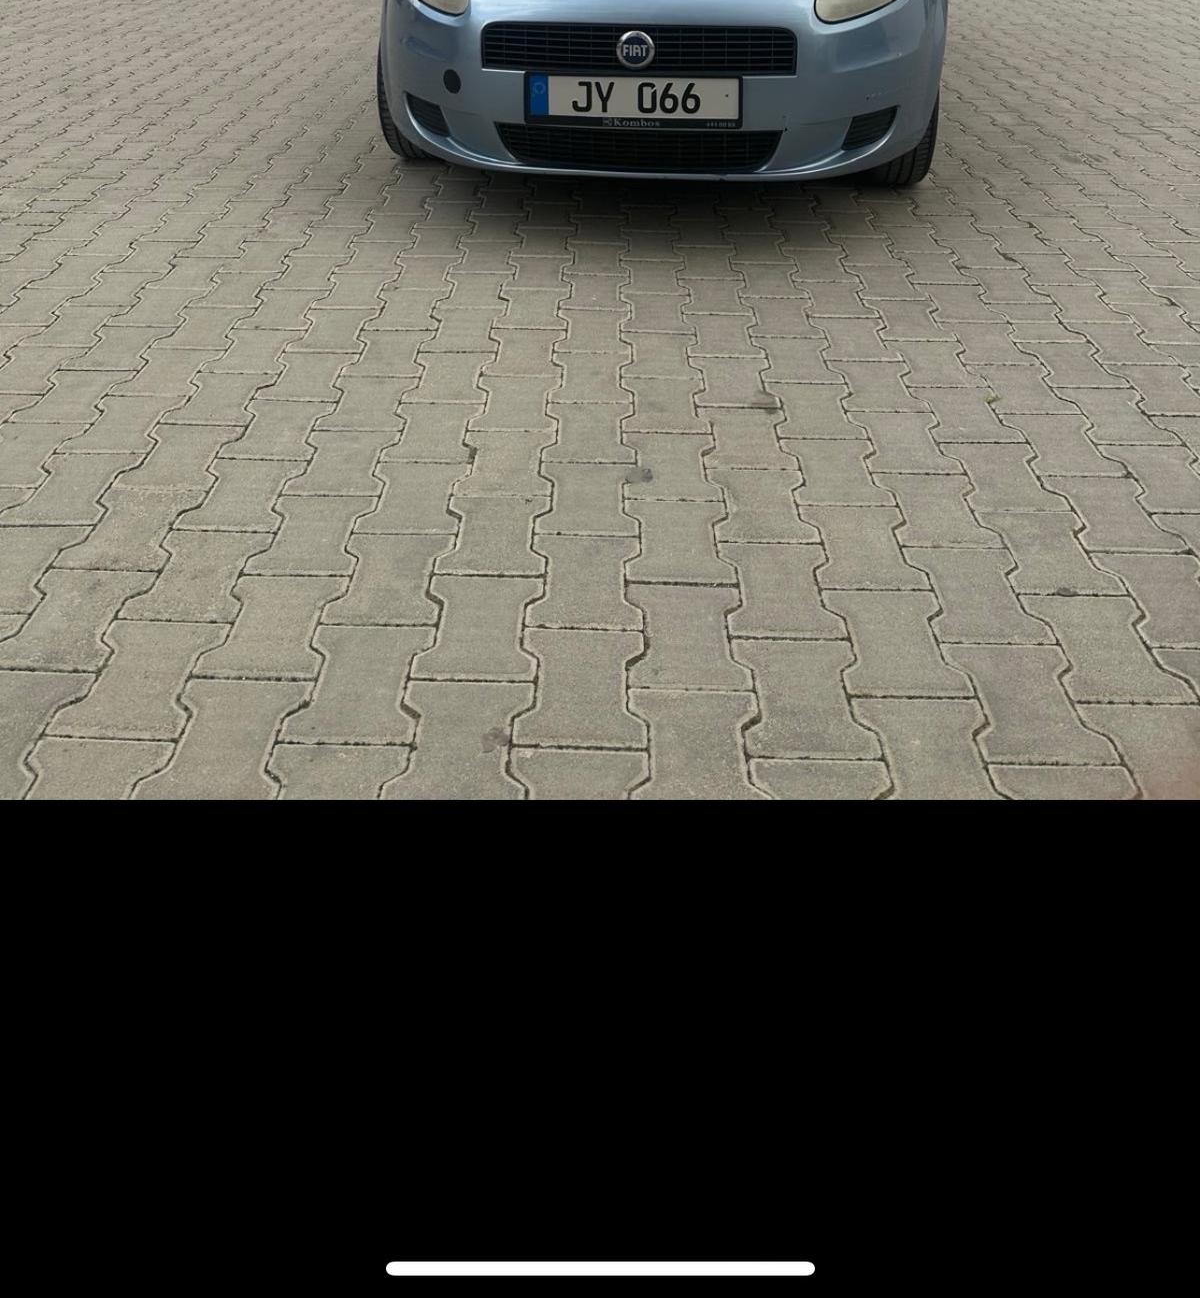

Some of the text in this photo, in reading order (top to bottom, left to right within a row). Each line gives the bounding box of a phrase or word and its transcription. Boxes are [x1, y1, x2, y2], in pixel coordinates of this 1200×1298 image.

[622, 44, 648, 57] FIAT
[572, 81, 701, 114] JY 066
